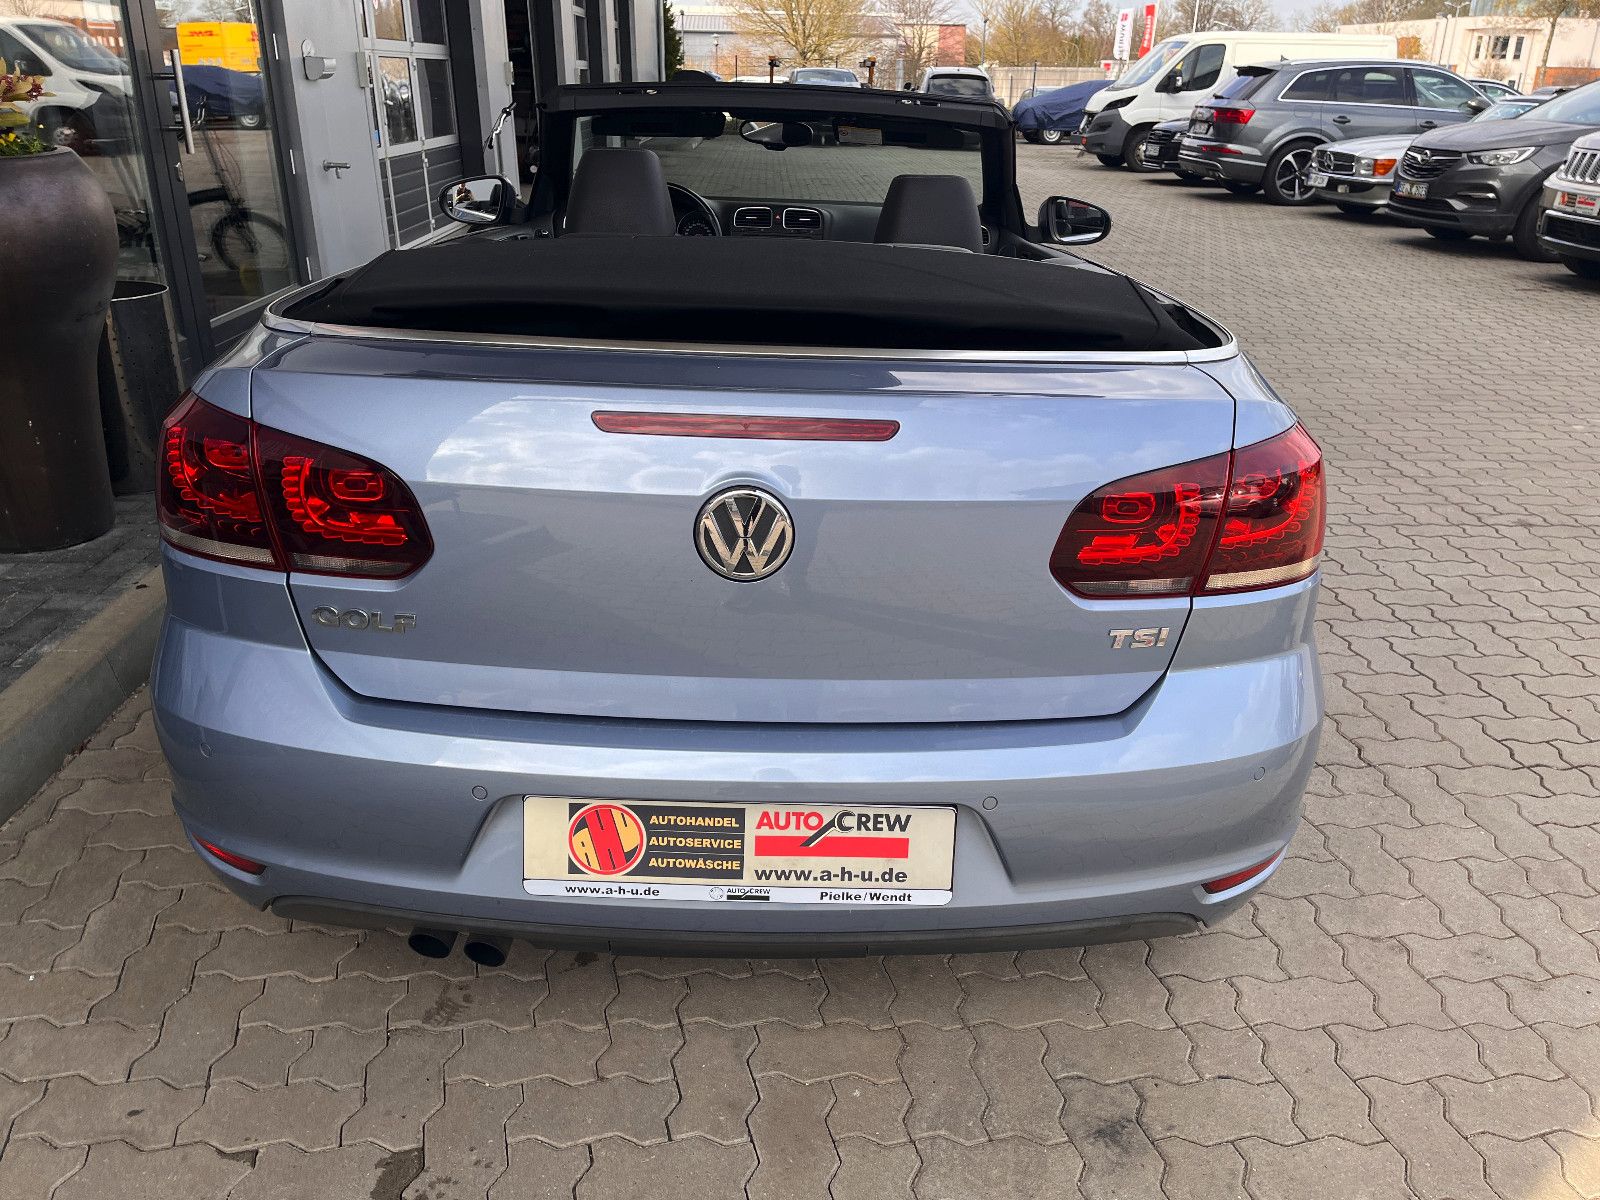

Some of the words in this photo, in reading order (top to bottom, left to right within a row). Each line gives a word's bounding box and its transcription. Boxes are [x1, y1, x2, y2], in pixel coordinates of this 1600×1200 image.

[311, 605, 417, 634] GOLF
[1108, 627, 1170, 649] TSI
[649, 815, 740, 828] AUTOHANDEL
[755, 811, 824, 831] AUTO
[836, 810, 913, 833] CREW
[648, 836, 742, 849] AUTOSERVICE
[648, 857, 741, 870] AUTOWÄSCHE
[754, 867, 908, 883] www.a-h-u.de
[565, 885, 660, 897] www.a-h-u.de
